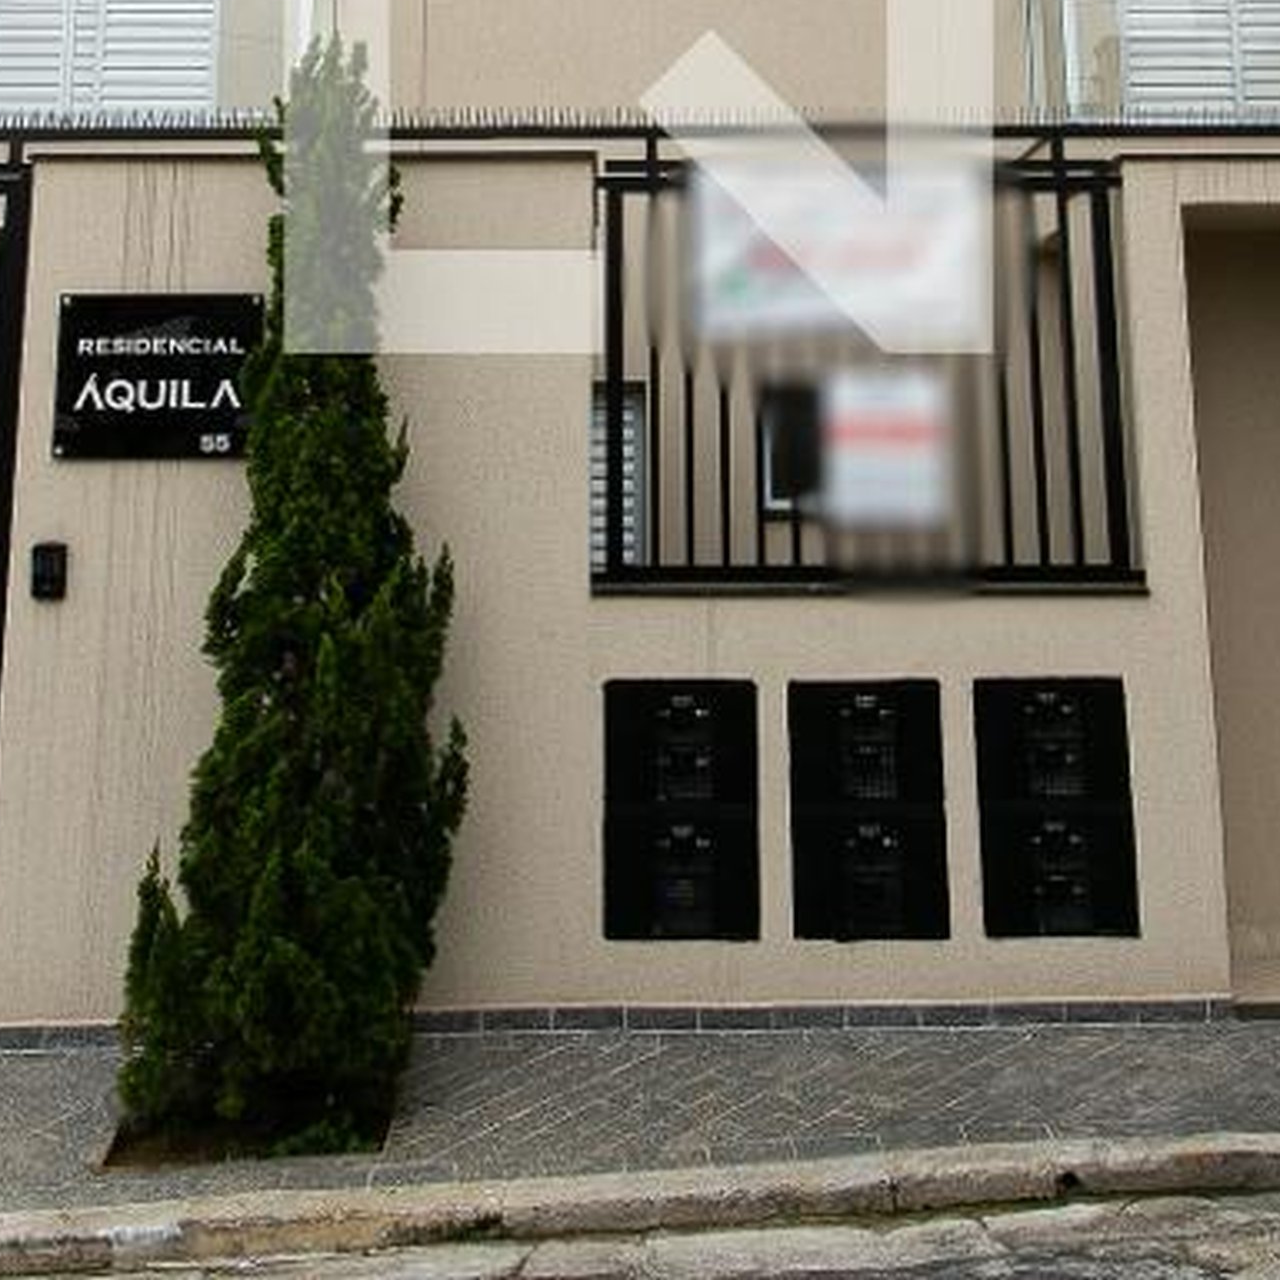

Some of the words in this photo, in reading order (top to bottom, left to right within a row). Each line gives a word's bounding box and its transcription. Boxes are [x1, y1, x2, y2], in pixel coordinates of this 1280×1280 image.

[77, 337, 245, 356] RESIDENCIAL
[73, 372, 241, 413] ÁQUILA
[199, 433, 231, 453] 55
